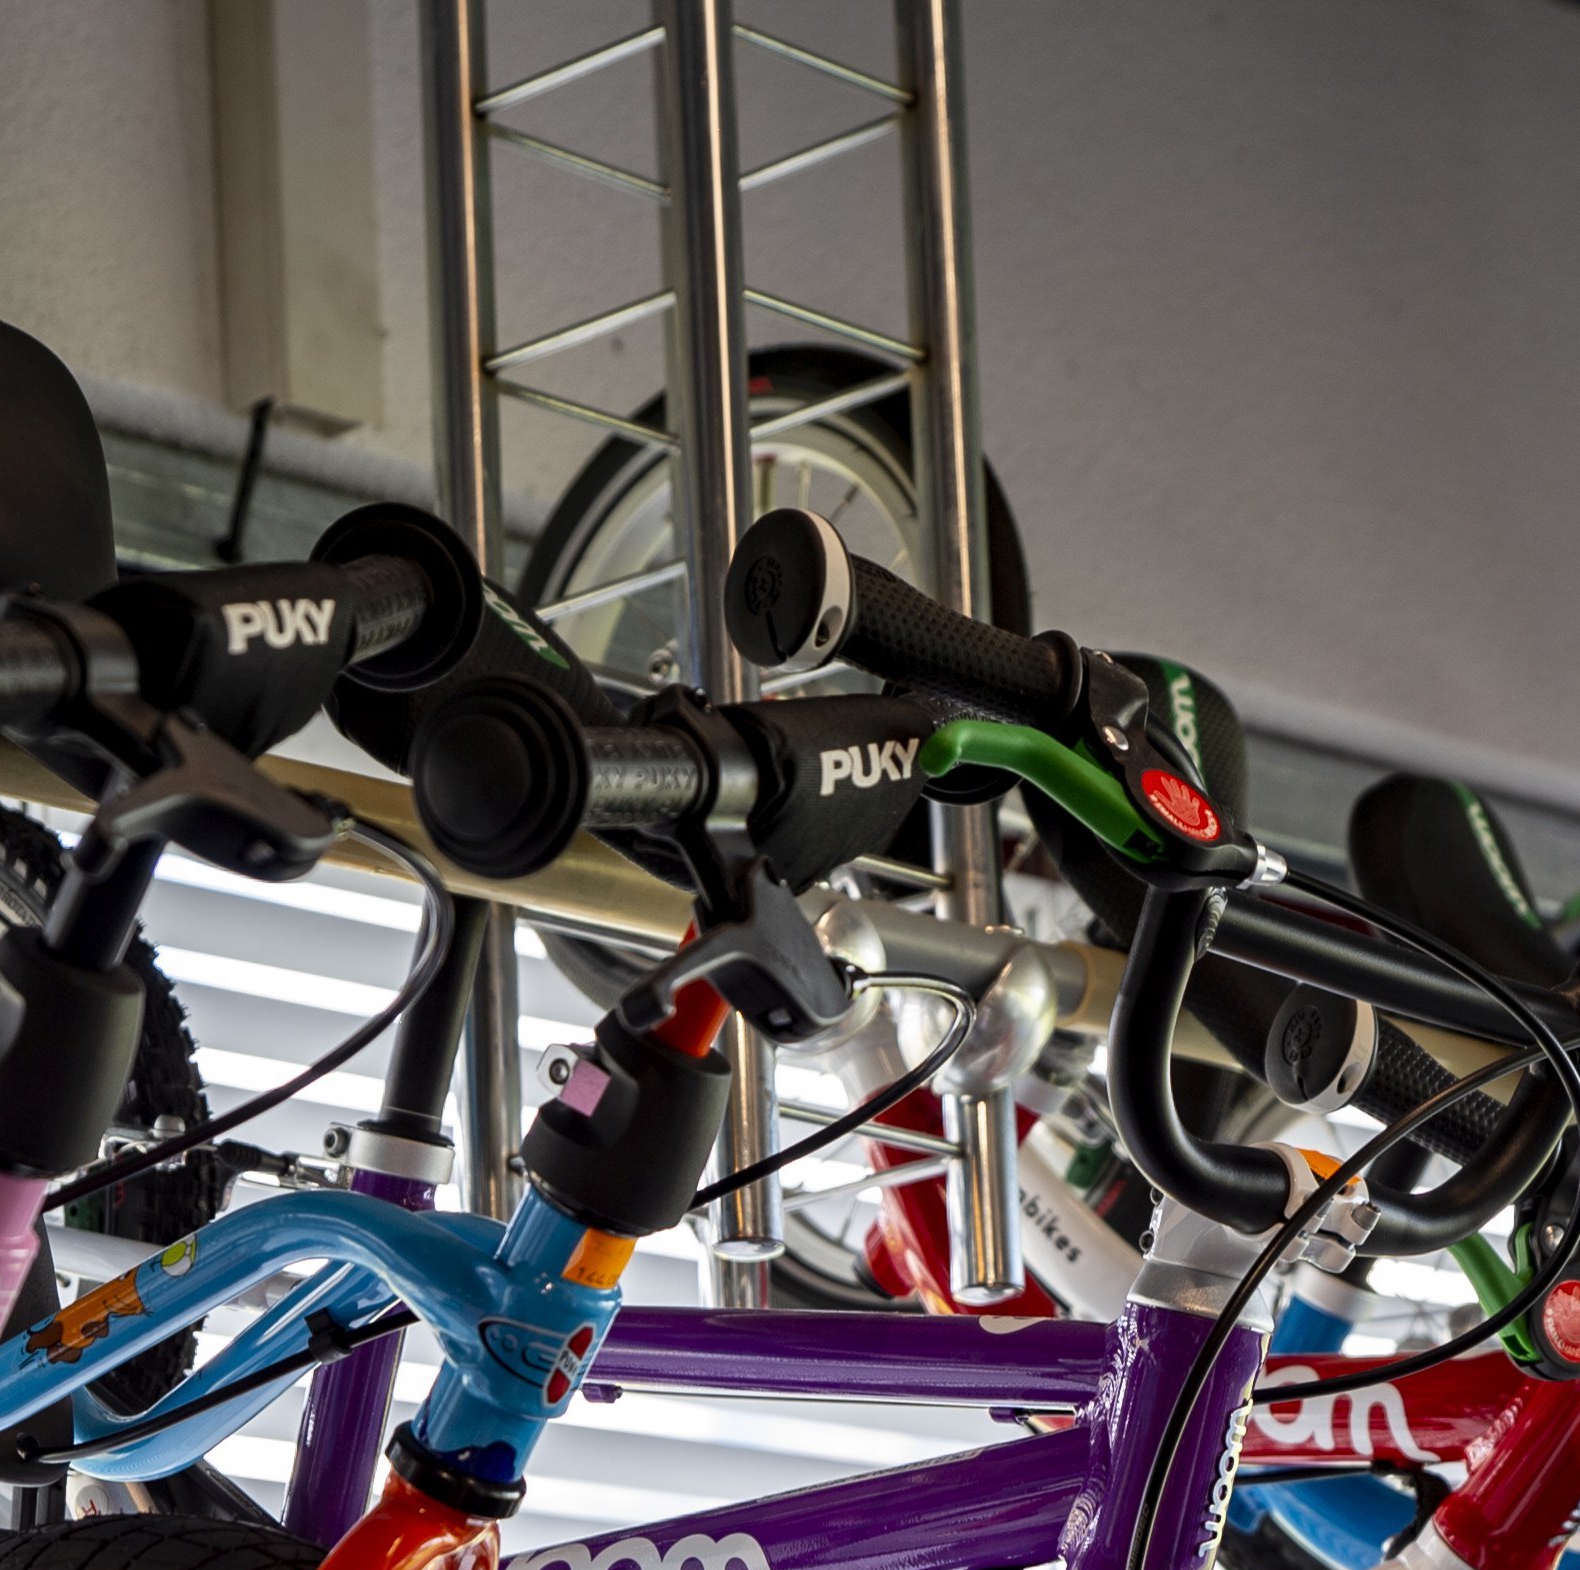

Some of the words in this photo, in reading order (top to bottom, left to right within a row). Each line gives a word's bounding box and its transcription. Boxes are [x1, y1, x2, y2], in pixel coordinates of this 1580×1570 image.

[223, 599, 335, 654] PUKY
[820, 738, 919, 796] PUKY
[1198, 1399, 1253, 1557] woom
